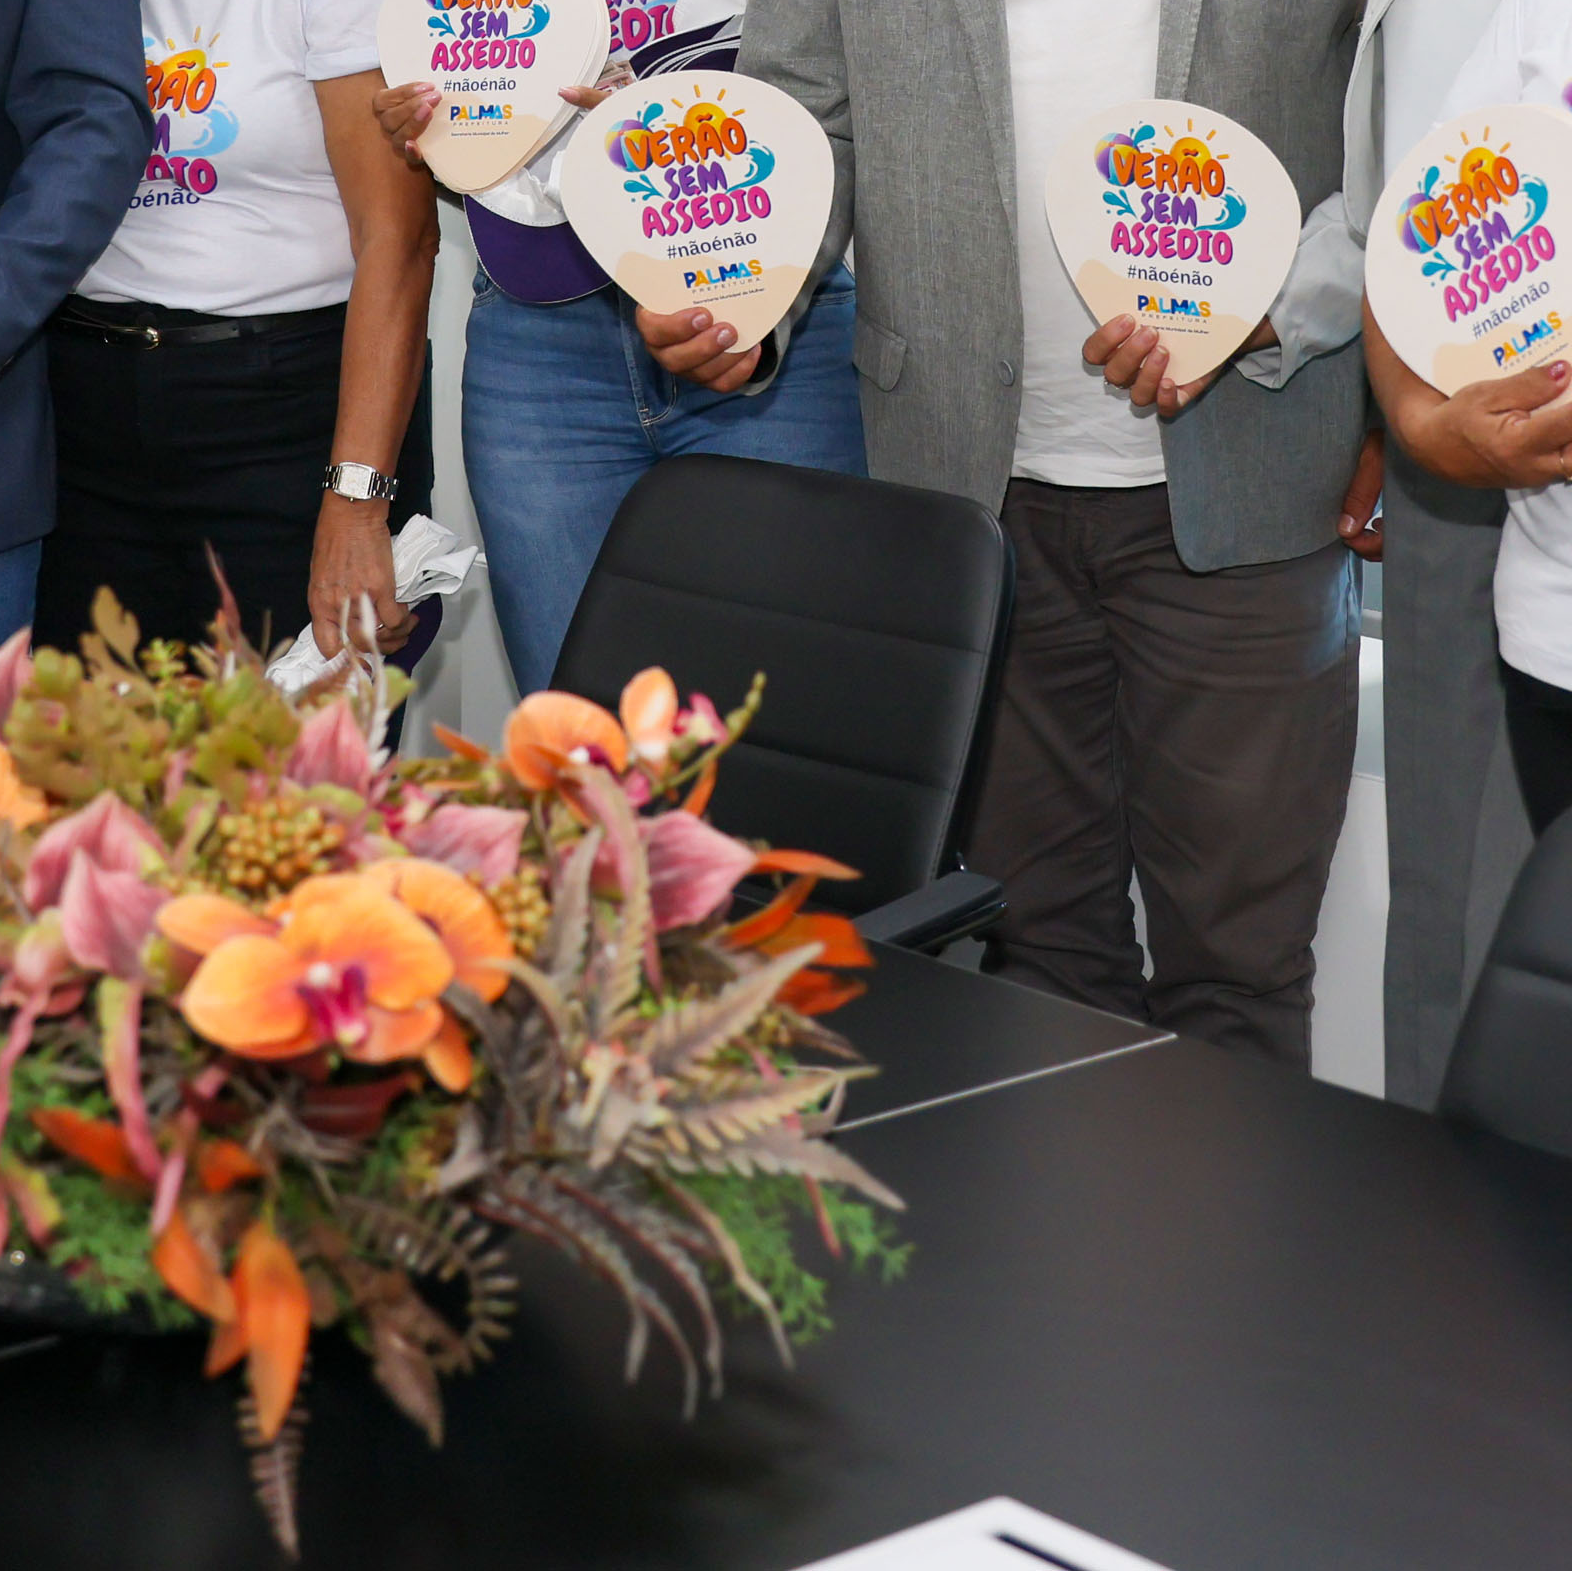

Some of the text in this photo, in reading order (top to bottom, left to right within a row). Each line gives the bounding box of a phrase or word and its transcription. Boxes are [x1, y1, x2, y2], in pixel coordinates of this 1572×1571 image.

[459, 10, 509, 39] SEM
[144, 60, 217, 115] RÃO
[443, 75, 517, 94] #nãoénão
[450, 104, 513, 120] PALMAS
[623, 114, 748, 171] VERÃO
[663, 162, 728, 199] SEM
[1112, 148, 1226, 198] VERÃO
[128, 187, 201, 209] oénão
[1140, 191, 1198, 227] SEM
[1412, 155, 1520, 248] VERÃO
[667, 232, 757, 259] #nãoénão
[1454, 211, 1512, 270] SEM
[683, 259, 763, 288] PALMAS
[1127, 264, 1213, 287] #nãoénão
[1137, 294, 1212, 318] PALMAS
[1472, 280, 1550, 340] #nãoénão
[1492, 311, 1563, 367] PALMAS
